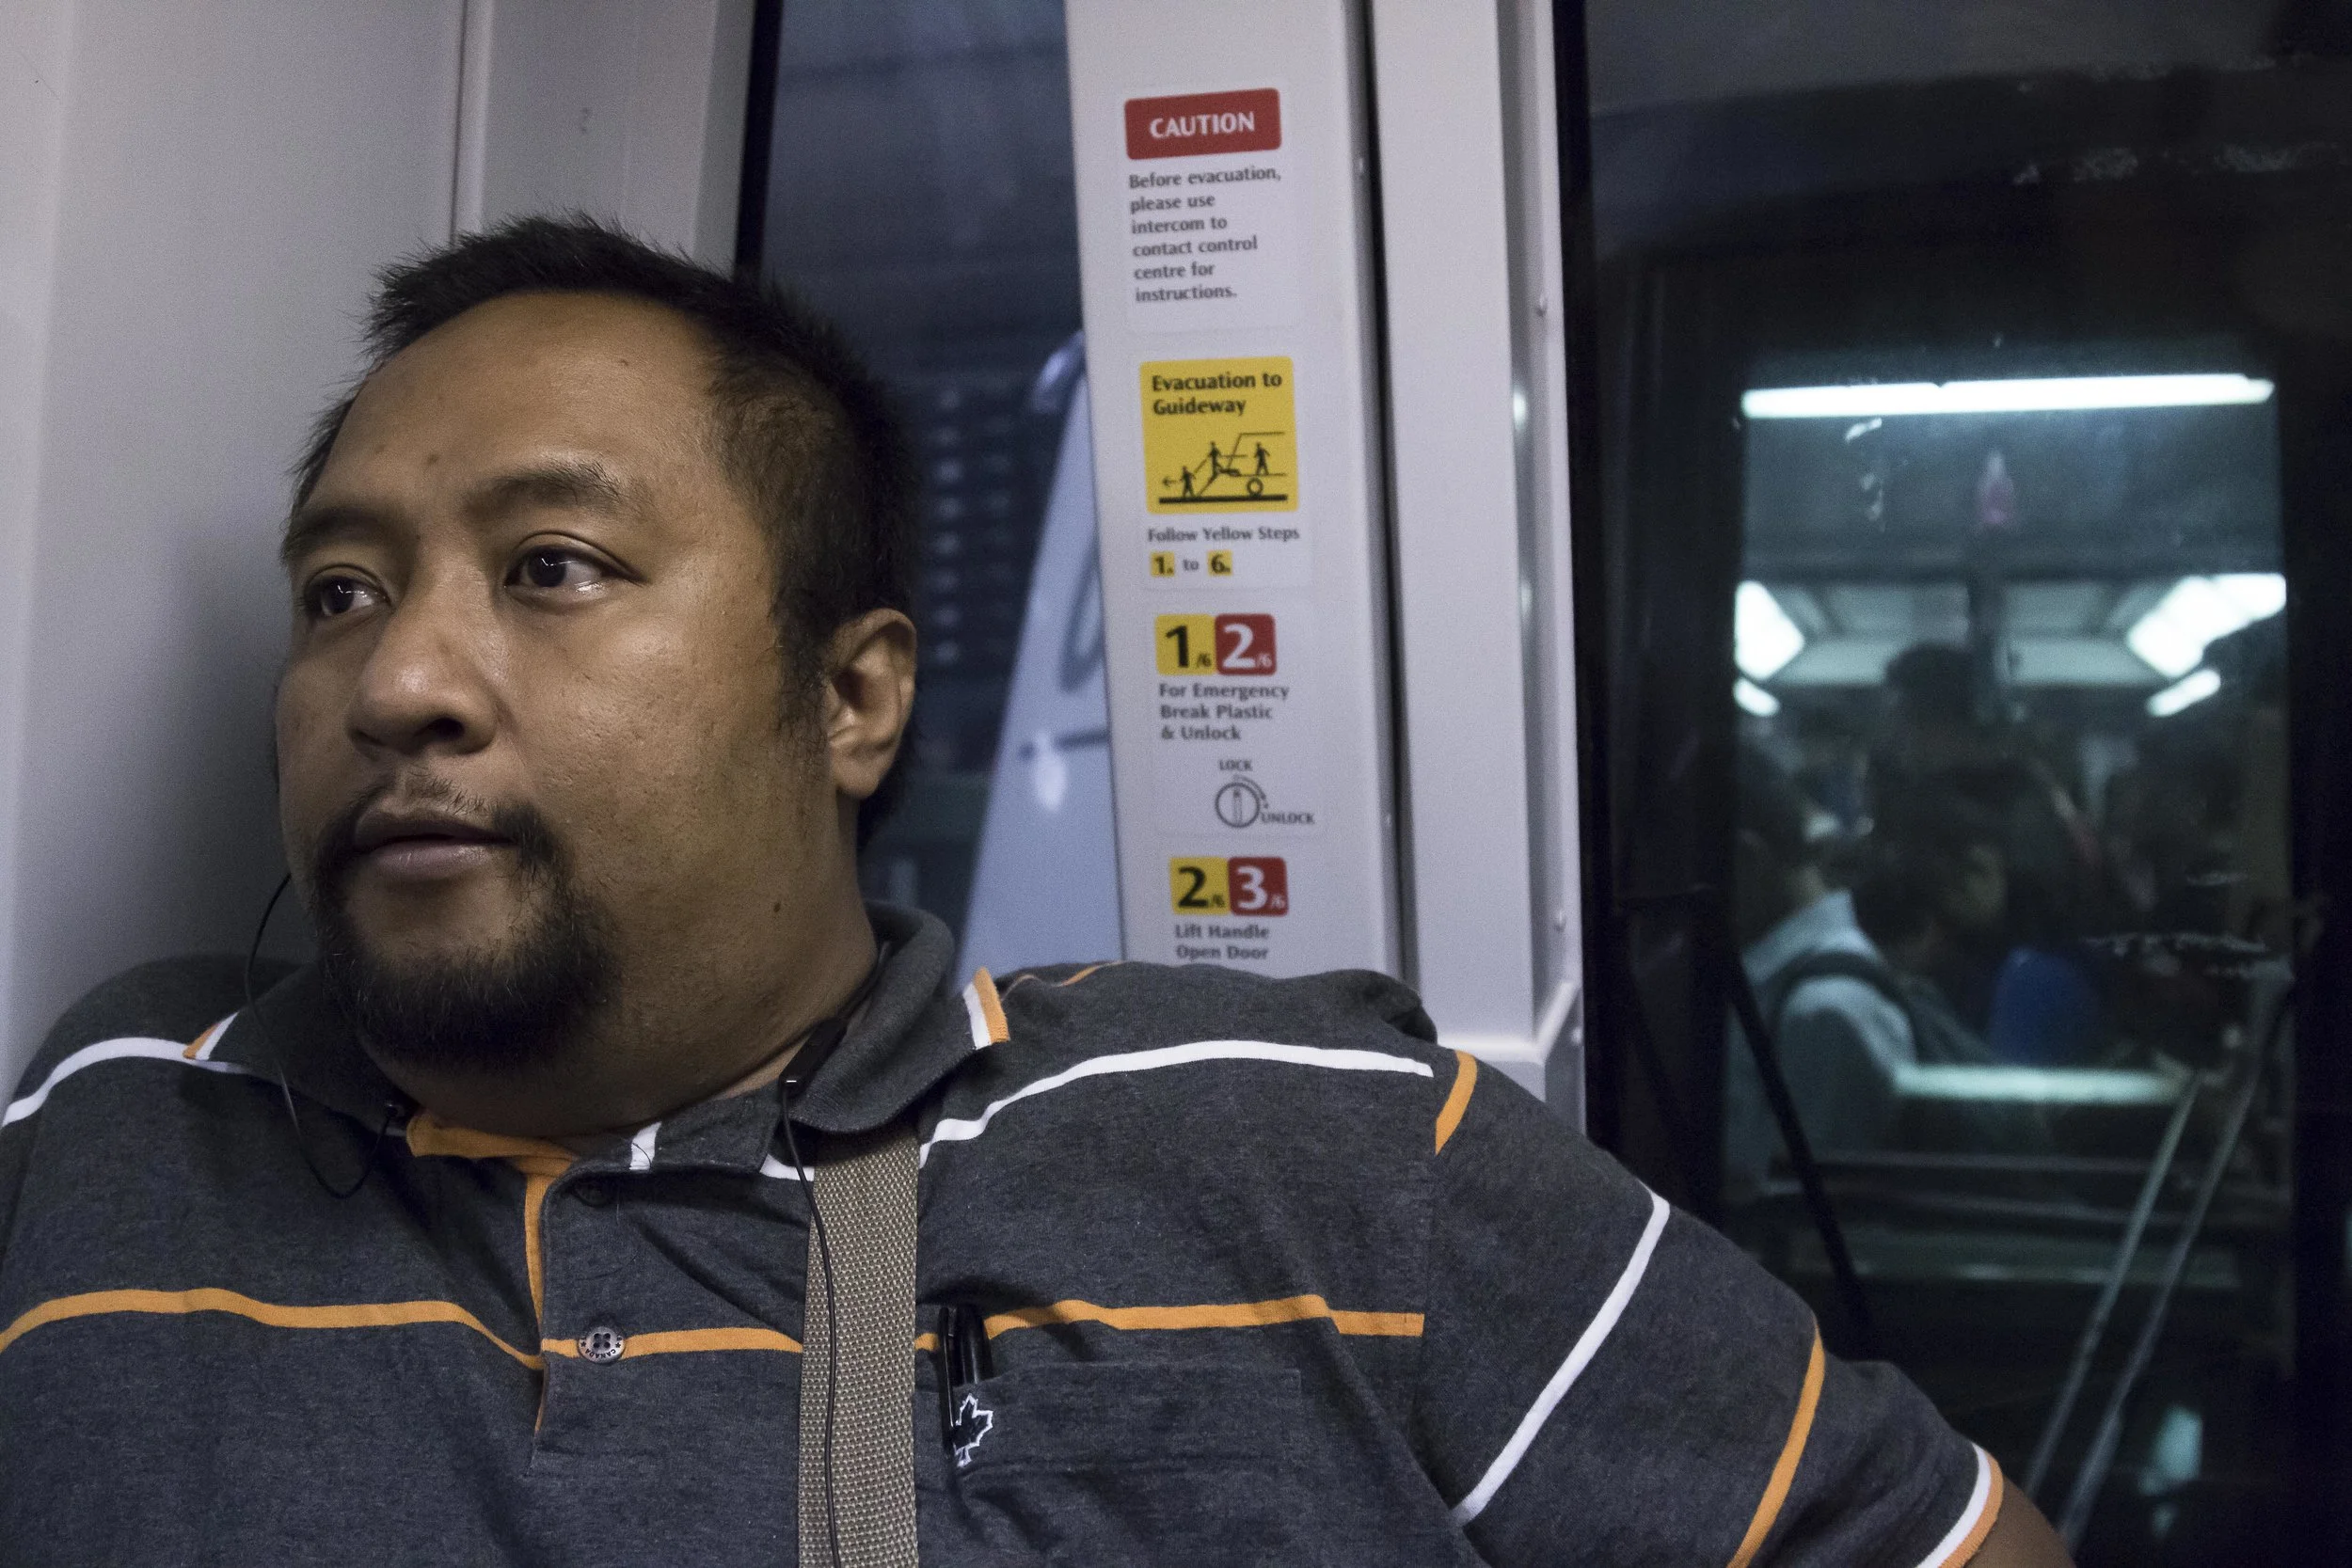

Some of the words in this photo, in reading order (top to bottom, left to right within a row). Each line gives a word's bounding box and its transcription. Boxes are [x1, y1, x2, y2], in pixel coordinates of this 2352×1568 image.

[1150, 112, 1255, 138] CAUTION
[1129, 172, 1181, 189] Before
[1187, 166, 1281, 185] evacuation,
[1130, 196, 1182, 215] please
[1186, 193, 1216, 209] use
[1132, 217, 1205, 234] intercom
[1210, 216, 1228, 231] to
[1133, 240, 1192, 257] contact
[1198, 234, 1258, 254] control
[1134, 264, 1186, 281] centre
[1190, 261, 1216, 277] for
[1136, 285, 1237, 302] instructions.
[1151, 372, 1256, 392] Evacuation
[1262, 372, 1283, 388] to
[1152, 396, 1247, 417] Guideway
[1147, 527, 1199, 543] Follow
[1201, 526, 1252, 542] Yellow
[1257, 525, 1300, 542] Steps
[1182, 558, 1200, 572] to
[1158, 682, 1187, 698] For
[1191, 682, 1290, 701] Emergency
[1159, 704, 1210, 720] Break
[1216, 703, 1273, 720] Plastic
[1160, 725, 1174, 740] &
[1180, 723, 1242, 740] Unlock
[1219, 759, 1252, 771] LOCK
[1261, 812, 1315, 825] UNLOCK
[1175, 925, 1202, 939] Lift
[1208, 924, 1270, 939] Handle
[1175, 945, 1221, 961] Open
[1226, 944, 1268, 959] Door
[584, 1348, 616, 1359] CANADA
